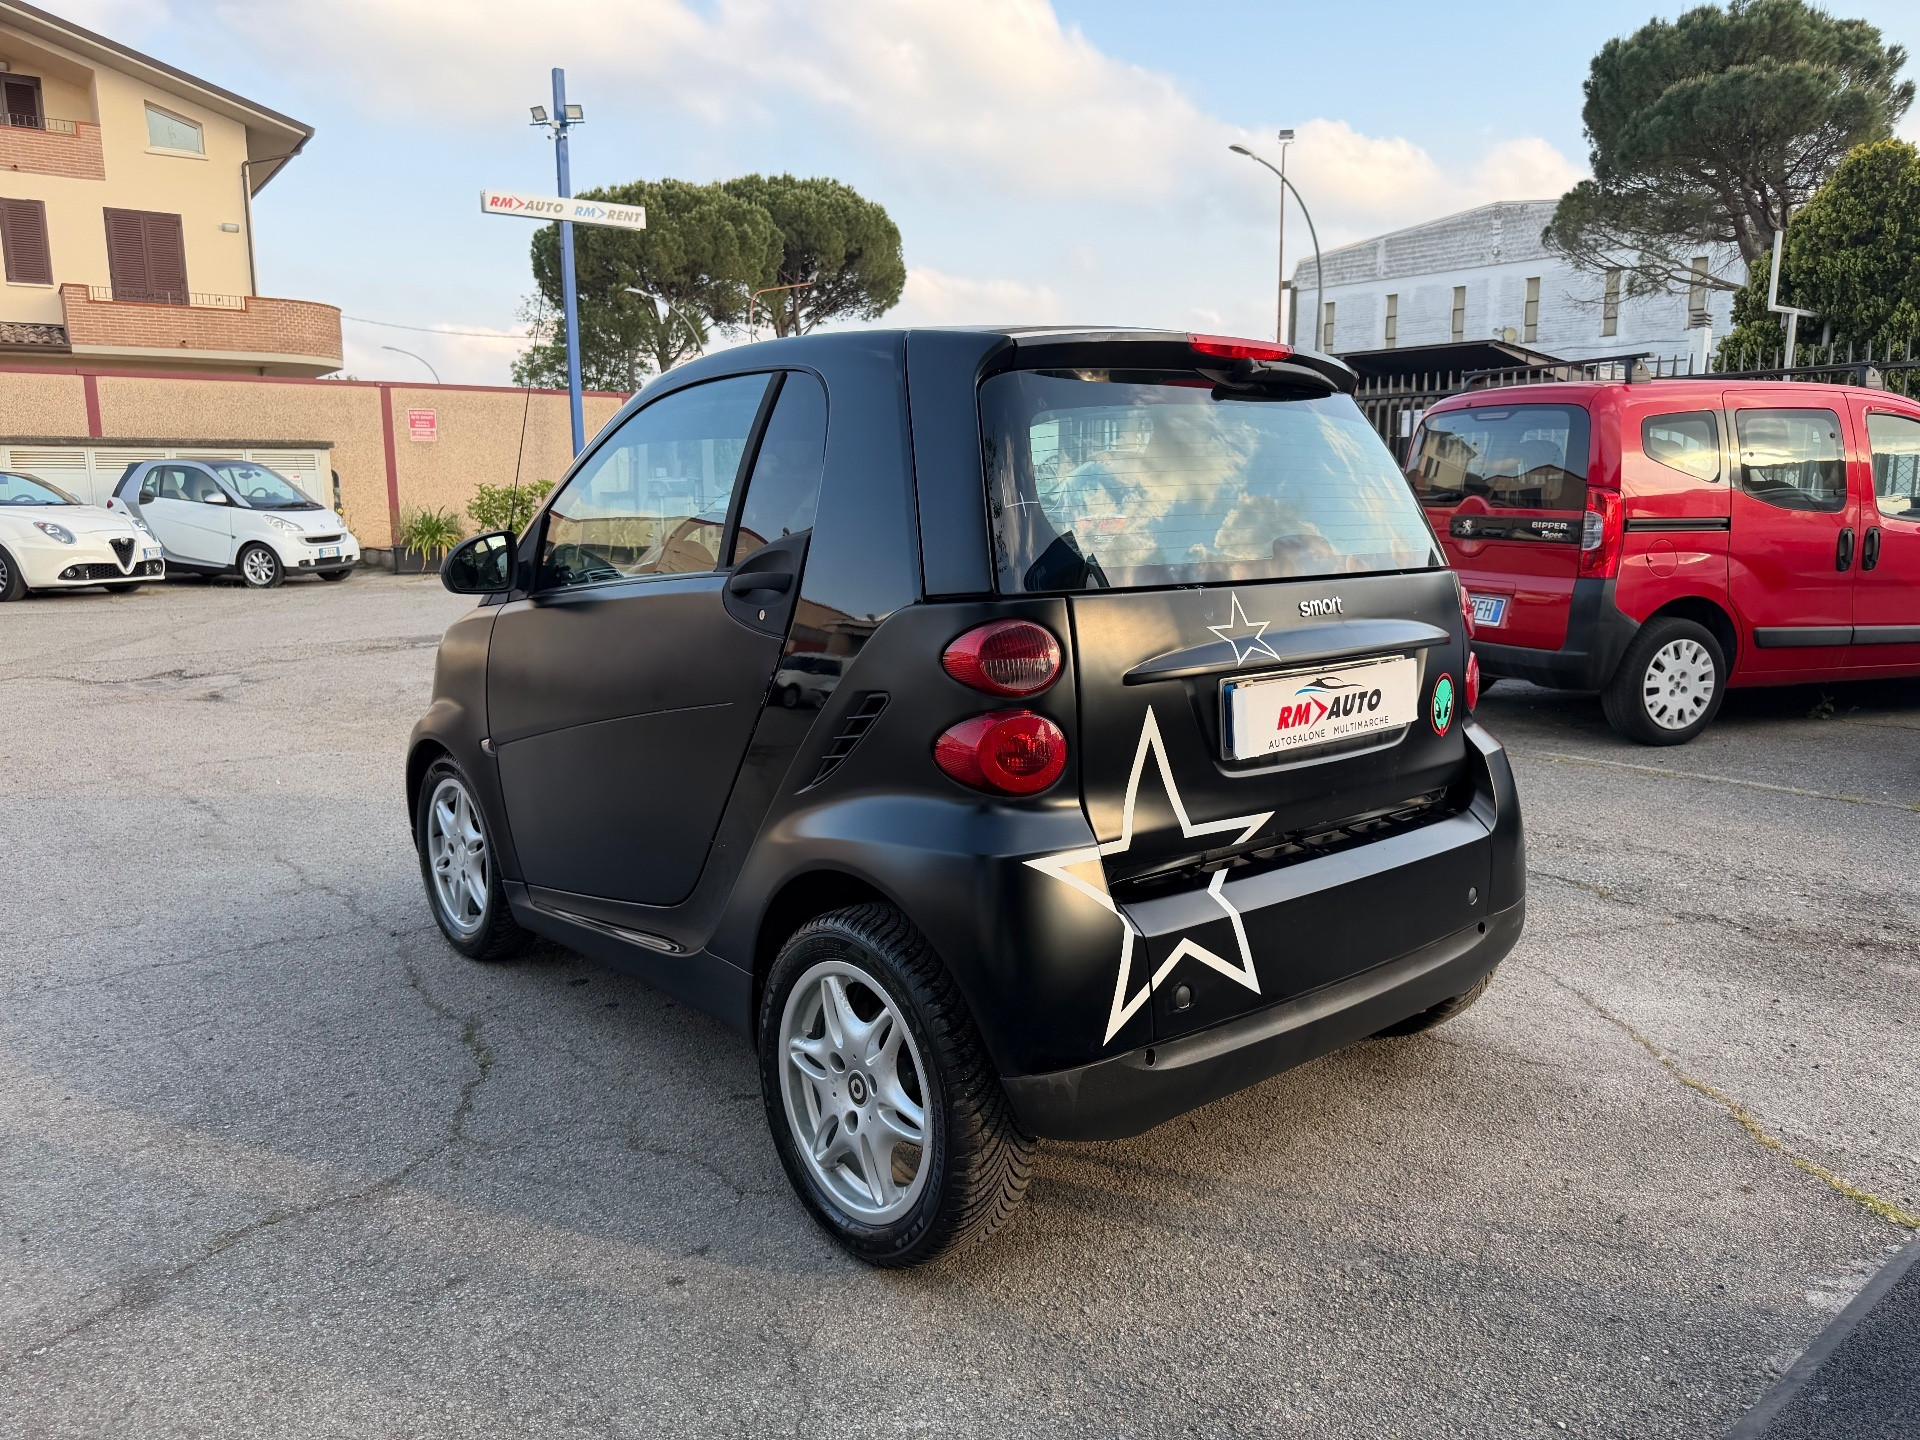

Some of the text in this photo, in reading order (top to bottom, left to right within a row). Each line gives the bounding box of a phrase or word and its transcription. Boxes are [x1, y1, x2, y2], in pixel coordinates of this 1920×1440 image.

[1531, 521, 1568, 530] BIPPER
[1299, 596, 1344, 618] smart
[1268, 715, 1389, 750] AUTOSALONE MULTIMARCHE
